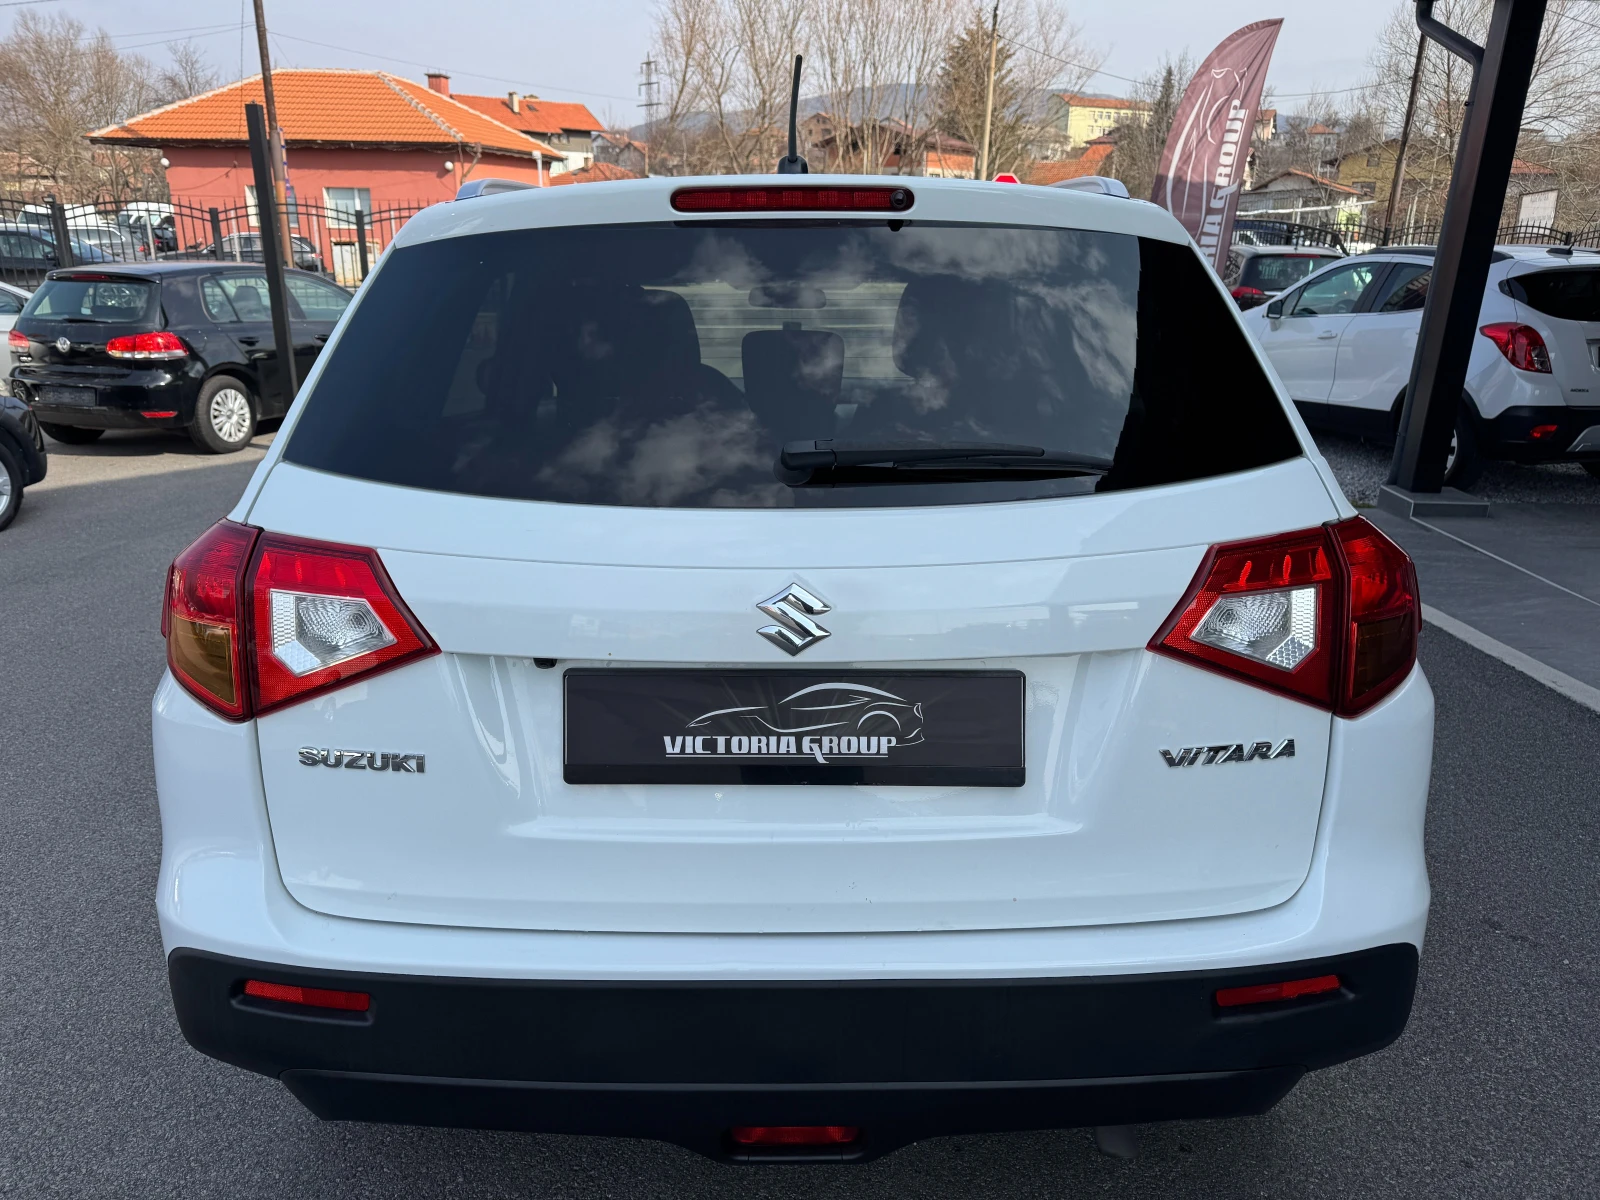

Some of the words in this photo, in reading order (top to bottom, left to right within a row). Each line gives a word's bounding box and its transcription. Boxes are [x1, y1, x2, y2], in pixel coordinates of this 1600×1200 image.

[1209, 98, 1246, 209] GROUP
[1200, 214, 1223, 268] RIA
[298, 746, 426, 774] SUZUKI
[663, 735, 797, 754] VICTORIA
[802, 736, 897, 764] GROUP
[1158, 738, 1296, 768] VITARA
